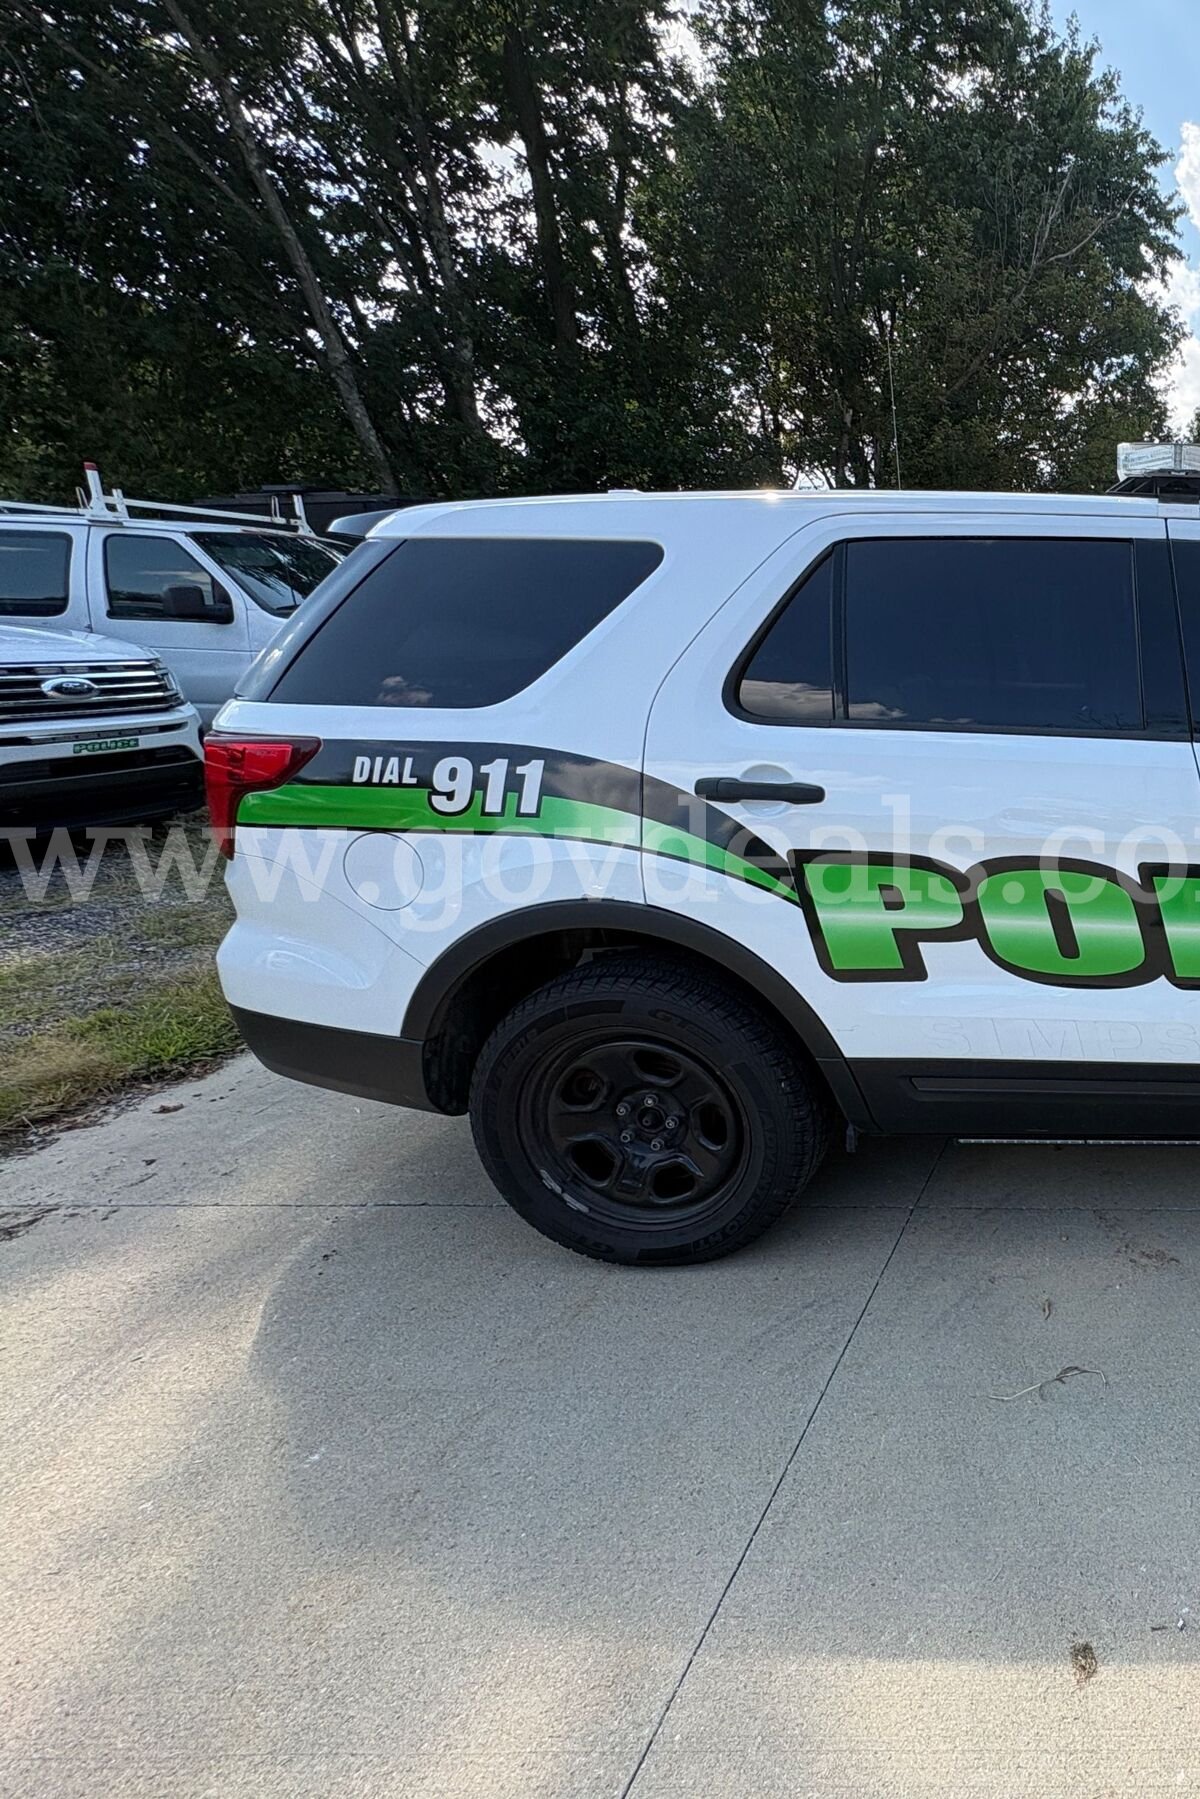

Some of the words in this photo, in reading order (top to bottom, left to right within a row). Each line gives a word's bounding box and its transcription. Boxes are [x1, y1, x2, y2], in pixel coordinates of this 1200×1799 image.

[73, 737, 139, 754] POLICE
[352, 756, 418, 784] DIAL
[430, 756, 545, 815] 911
